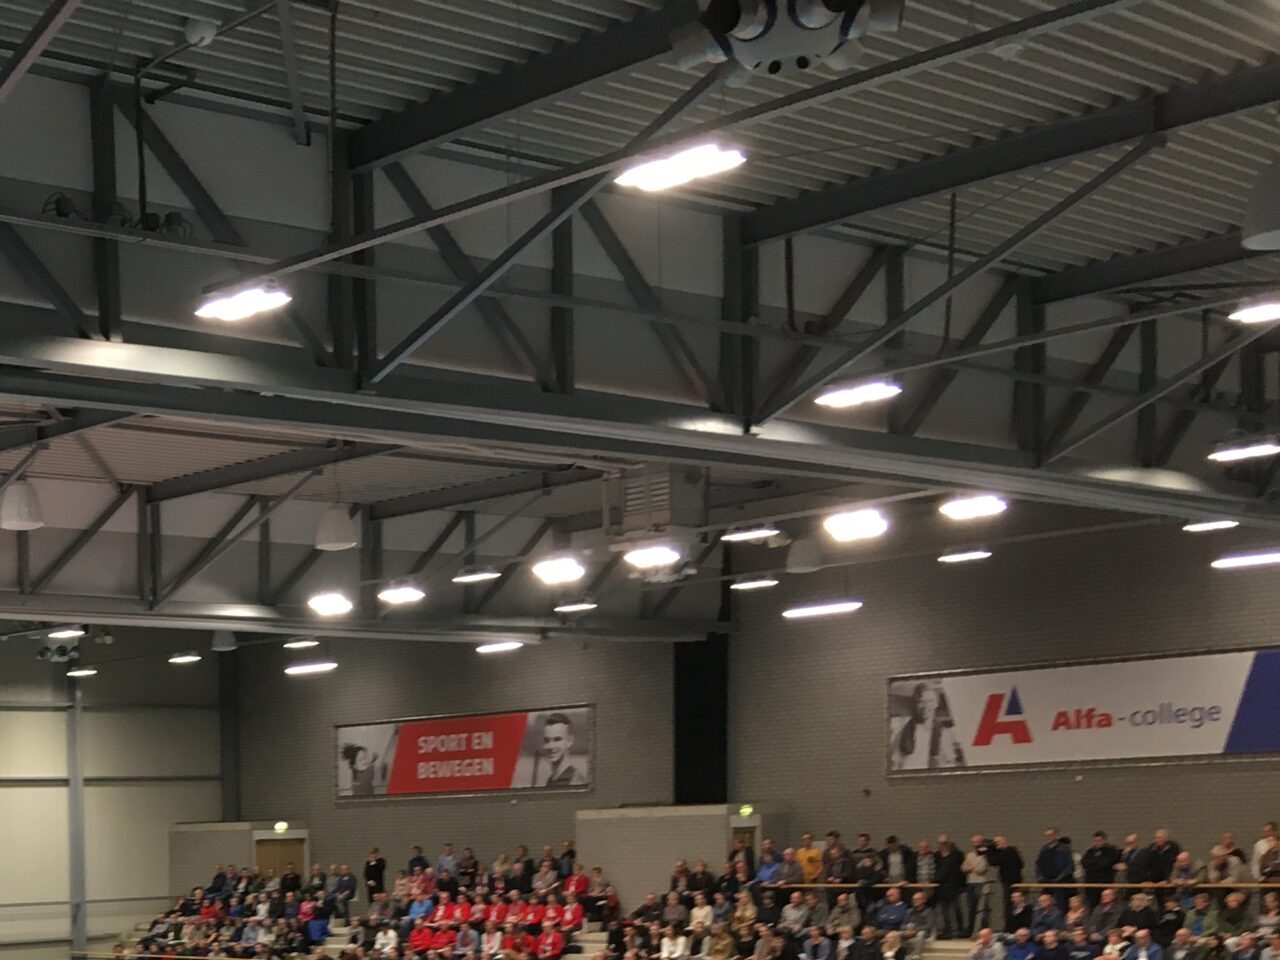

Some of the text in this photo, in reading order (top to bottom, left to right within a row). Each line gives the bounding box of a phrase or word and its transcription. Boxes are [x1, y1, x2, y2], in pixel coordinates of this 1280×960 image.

[417, 731, 494, 754] SPORT EN
[416, 758, 494, 779] BEWEGEN
